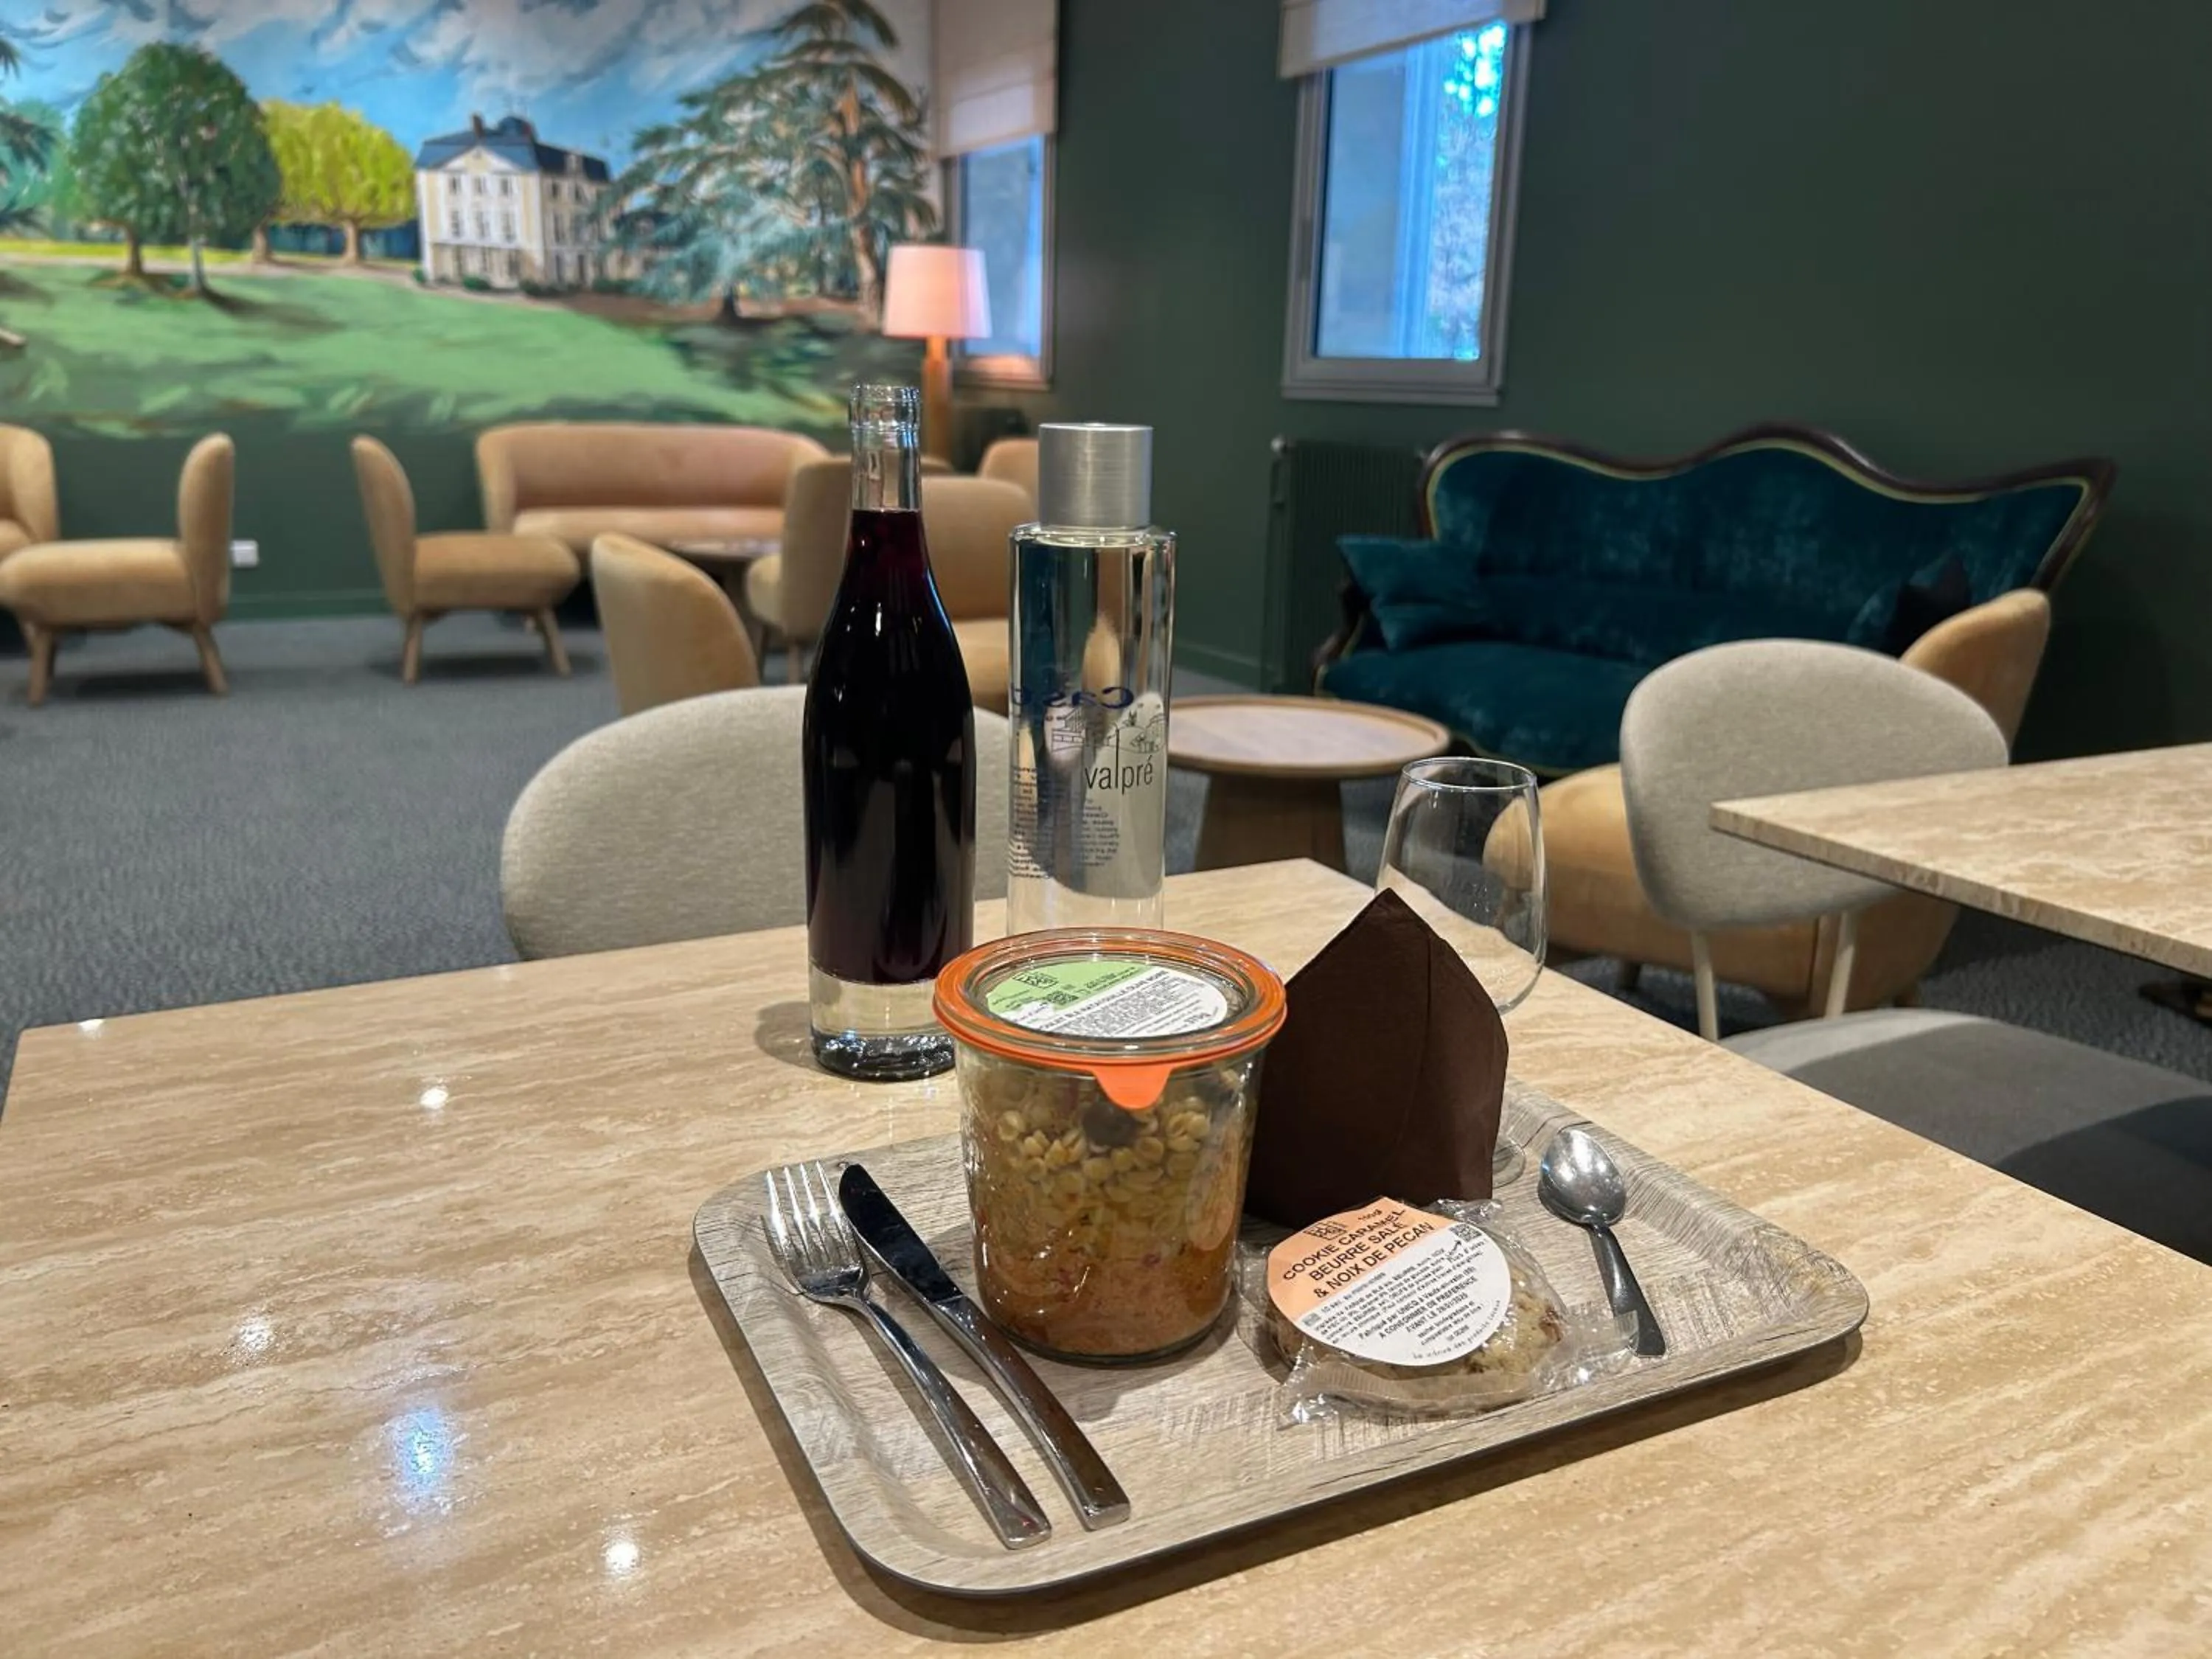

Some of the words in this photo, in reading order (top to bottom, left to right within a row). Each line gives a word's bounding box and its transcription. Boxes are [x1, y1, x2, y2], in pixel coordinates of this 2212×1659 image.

[1085, 727, 1153, 796] valpré
[1283, 1244, 1339, 1280] COOKIE
[1339, 1209, 1405, 1245] CARAMEL
[1310, 1242, 1370, 1280] BEURRE
[1313, 1287, 1330, 1298] &
[1329, 1264, 1363, 1290] NOIX
[1362, 1249, 1387, 1267] DE
[1383, 1222, 1435, 1253] PECAN
